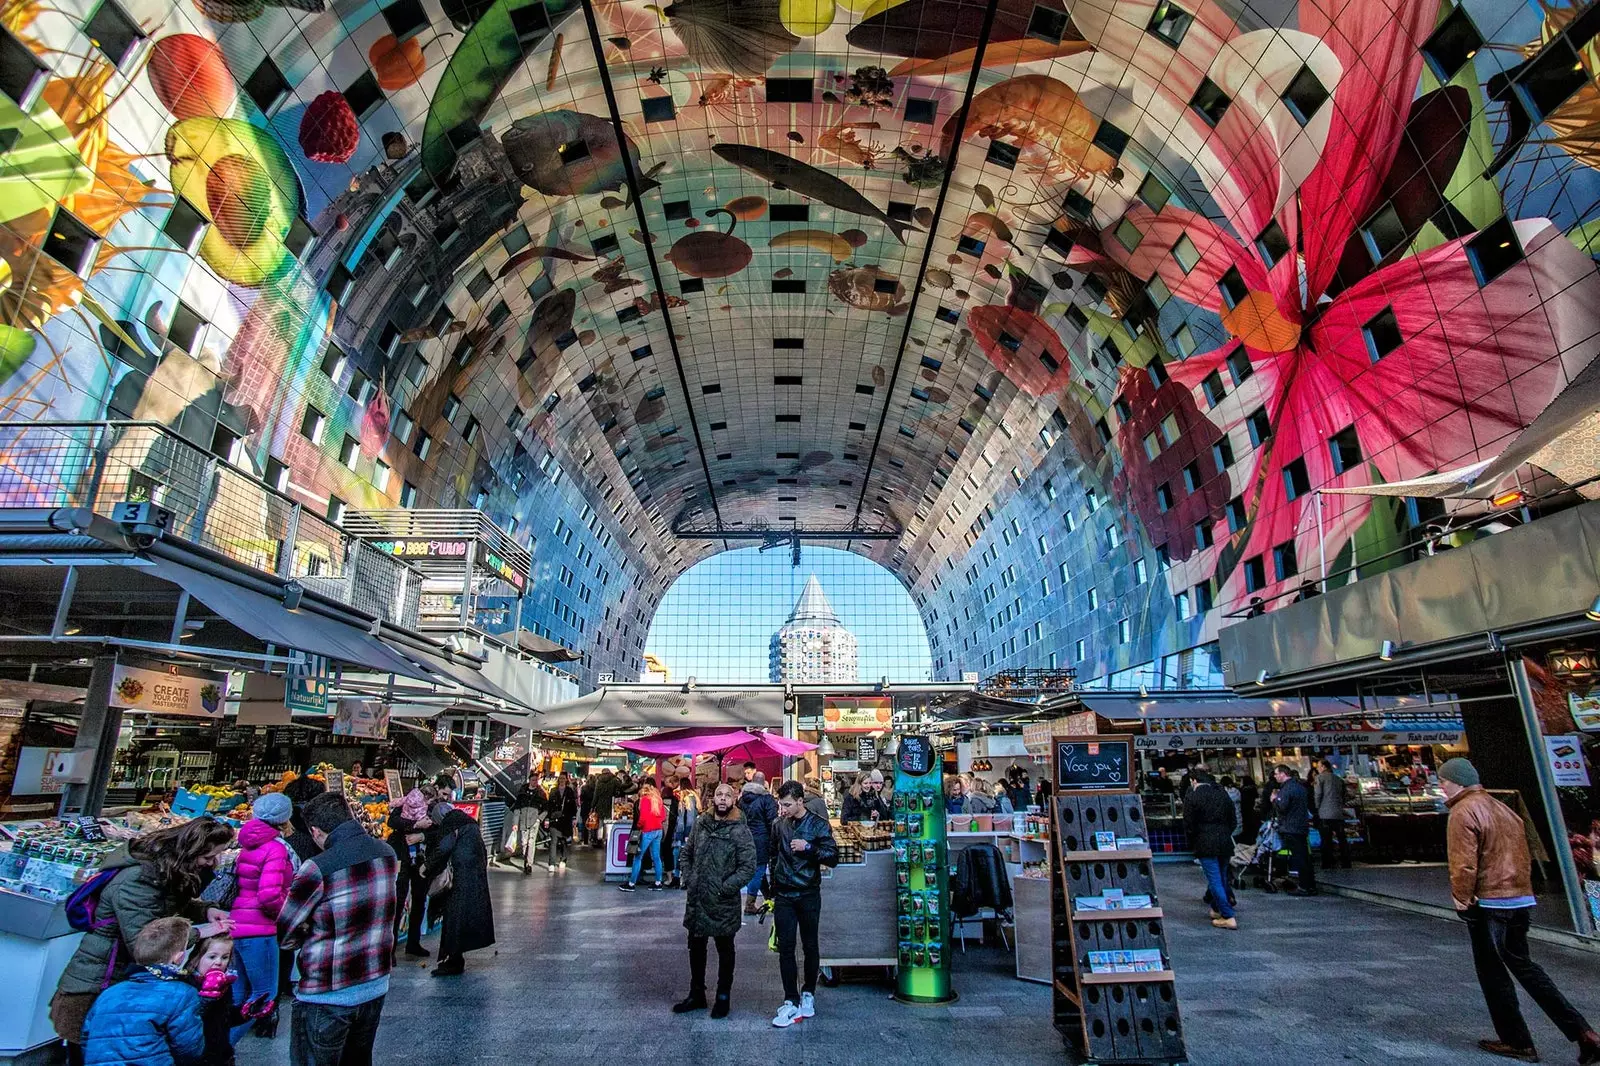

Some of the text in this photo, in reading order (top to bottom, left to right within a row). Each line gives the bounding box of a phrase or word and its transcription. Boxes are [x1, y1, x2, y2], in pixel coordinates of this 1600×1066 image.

[599, 674, 613, 682] 37
[153, 684, 190, 697] CREATE
[153, 694, 189, 704] YOUR OWN
[152, 701, 188, 710] MASTERPIECE
[1307, 734, 1315, 744] &
[1316, 734, 1332, 744] Vers
[1407, 731, 1423, 742] Fish
[1423, 732, 1439, 741] and
[1136, 737, 1157, 748] Chips
[1196, 737, 1232, 747] Arachide
[1064, 756, 1089, 773] Voor
